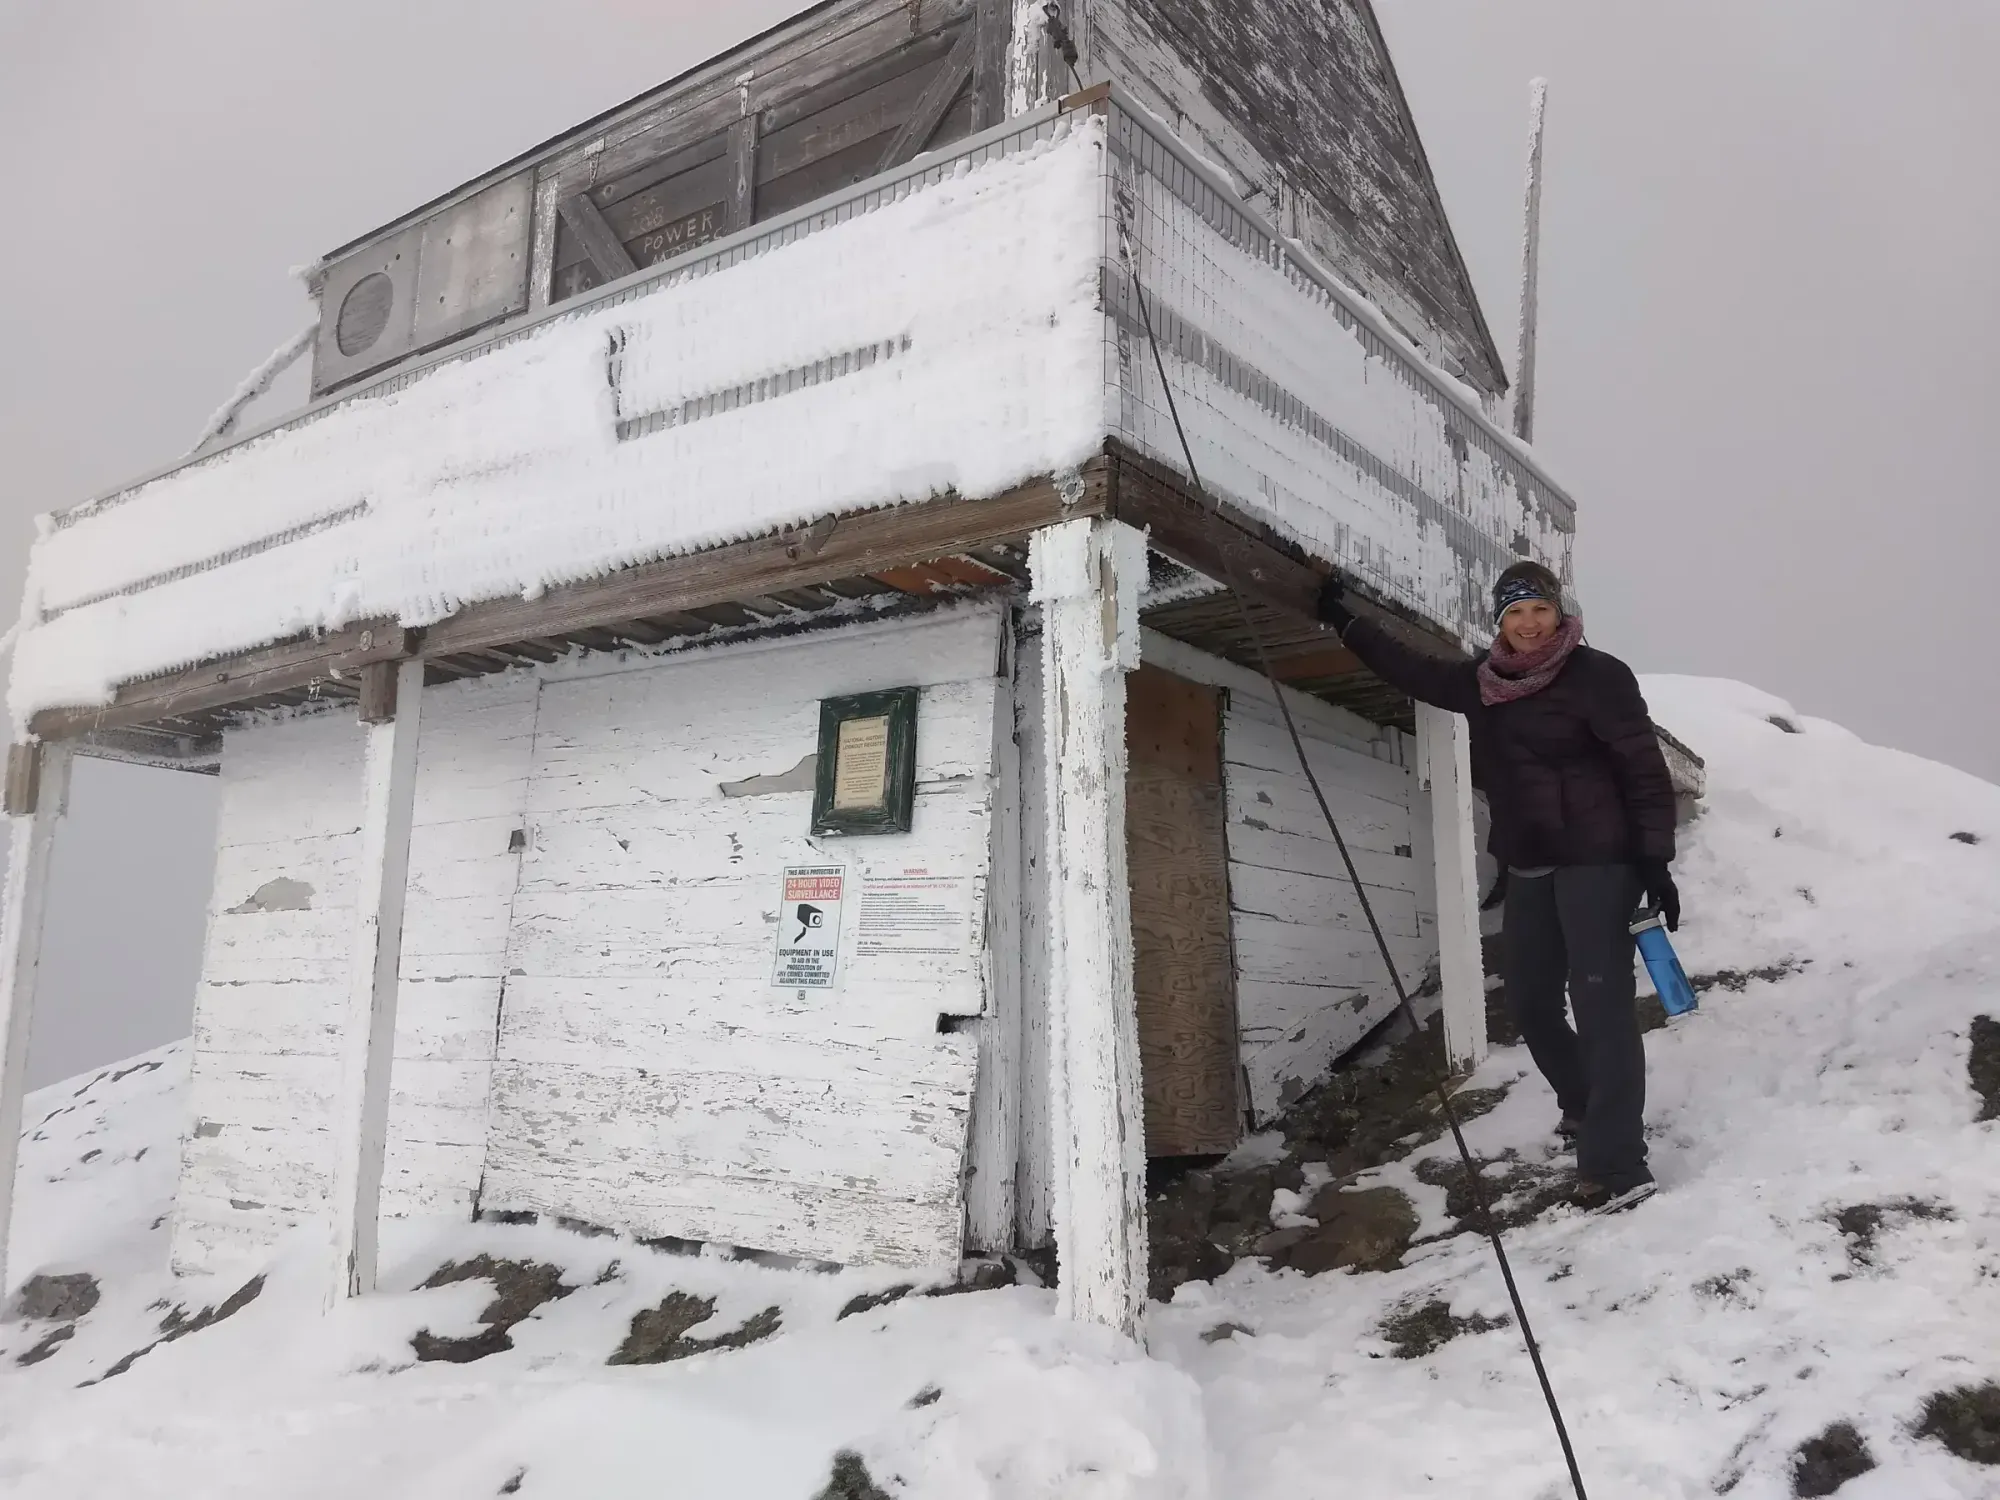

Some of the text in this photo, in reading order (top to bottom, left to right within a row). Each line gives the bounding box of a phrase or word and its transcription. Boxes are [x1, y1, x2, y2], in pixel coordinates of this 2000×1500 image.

[644, 211, 713, 253] POWER
[787, 878, 840, 888] 24 HOUR VIDEO
[788, 889, 838, 899] SURVEILLANCE
[822, 949, 834, 957] USE
